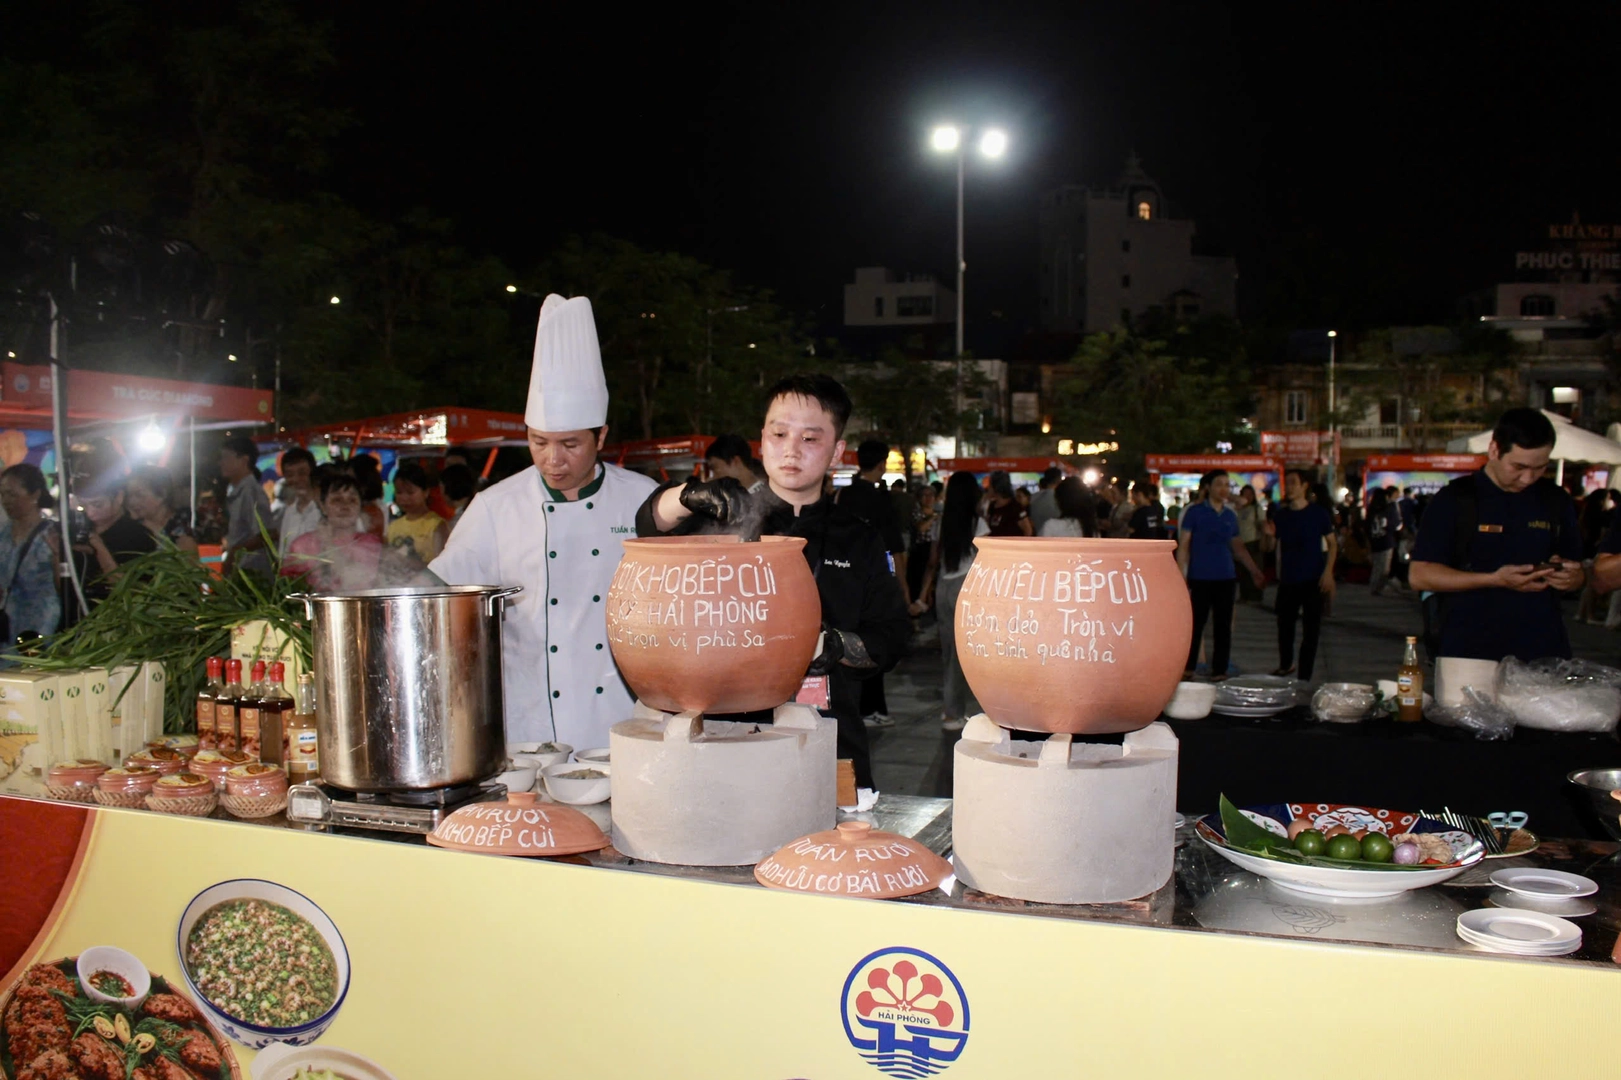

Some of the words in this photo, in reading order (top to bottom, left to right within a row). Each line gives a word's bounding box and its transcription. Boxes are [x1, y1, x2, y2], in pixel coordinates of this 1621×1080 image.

[681, 555, 734, 596] BẾP
[1053, 560, 1106, 603] BẾP
[647, 594, 685, 627] HẢI
[694, 596, 769, 627] PHÒNG
[1008, 604, 1040, 635] dẻo
[1057, 608, 1106, 637] Tròn
[1111, 615, 1135, 640] vị
[626, 630, 660, 649] trọn
[668, 632, 688, 651] vị
[696, 630, 737, 655] phù
[474, 823, 512, 847] BẾP
[846, 869, 881, 893] BÃI
[878, 1009, 894, 1020] HẢI
[897, 1013, 931, 1025] PHÒNG
